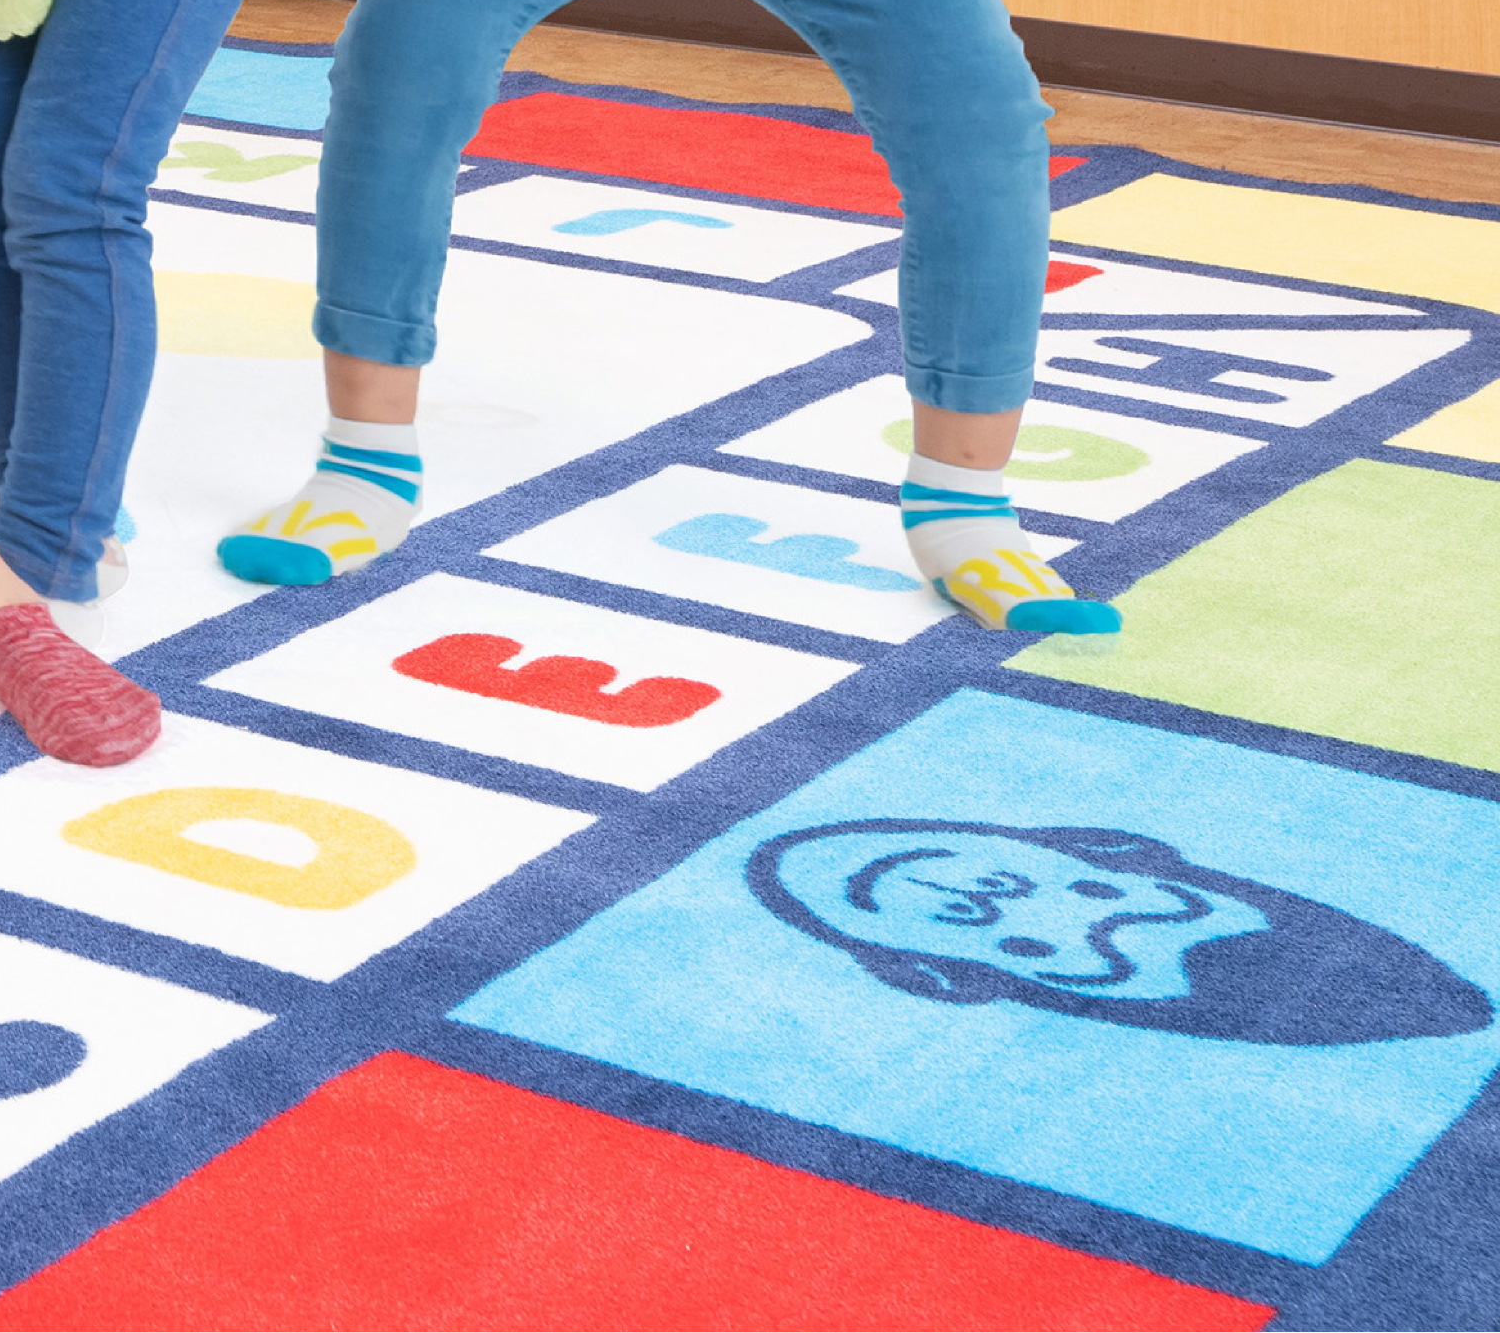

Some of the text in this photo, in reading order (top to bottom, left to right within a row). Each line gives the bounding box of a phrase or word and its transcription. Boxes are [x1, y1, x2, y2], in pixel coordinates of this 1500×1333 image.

[1045, 336, 1335, 404] H
[651, 513, 923, 593] F
[392, 633, 722, 729] E
[60, 785, 418, 911] D
